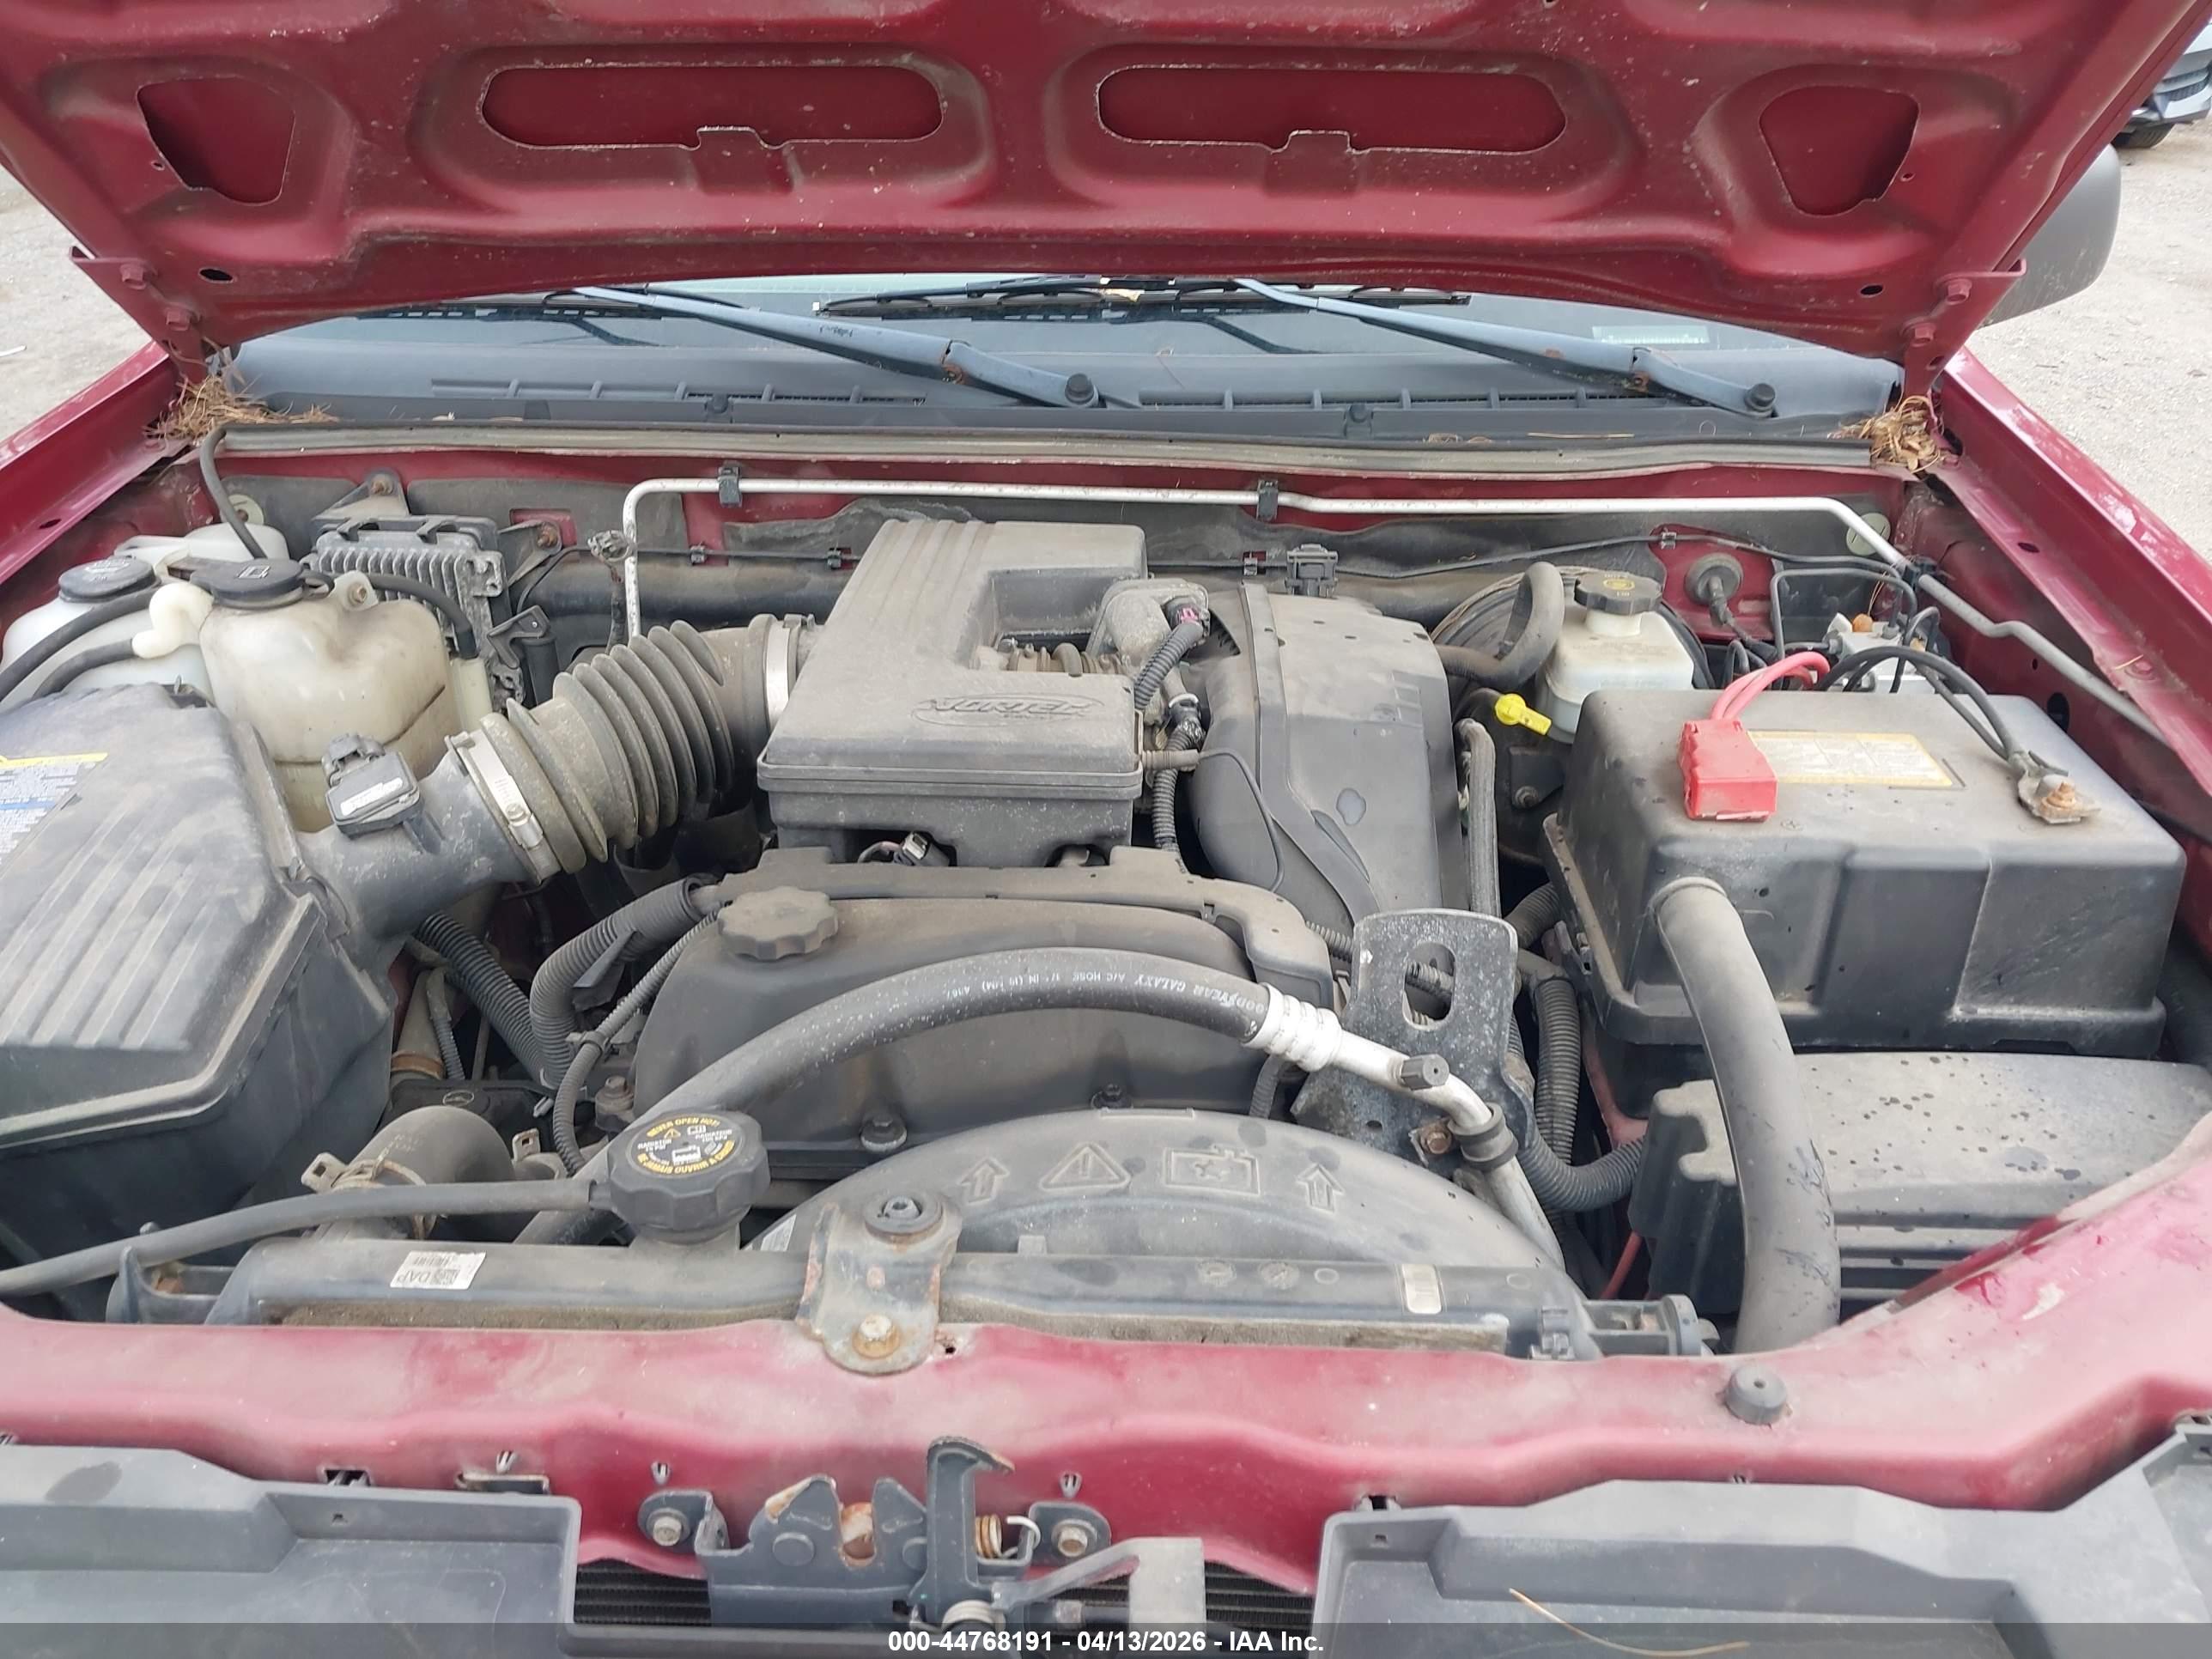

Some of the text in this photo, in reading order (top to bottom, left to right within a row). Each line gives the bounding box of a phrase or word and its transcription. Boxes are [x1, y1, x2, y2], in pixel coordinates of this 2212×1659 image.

[931, 696, 1089, 715] VORTEC
[1073, 971, 1102, 982] HOSE
[1106, 973, 1127, 982] A/C
[1133, 974, 1186, 993] GALAXY
[647, 1121, 674, 1137] NEVER
[674, 1117, 700, 1127] OPEN
[638, 1139, 672, 1149] RADIATOR
[674, 1159, 709, 1174] OUVRIR
[395, 1270, 431, 1284] DAP
